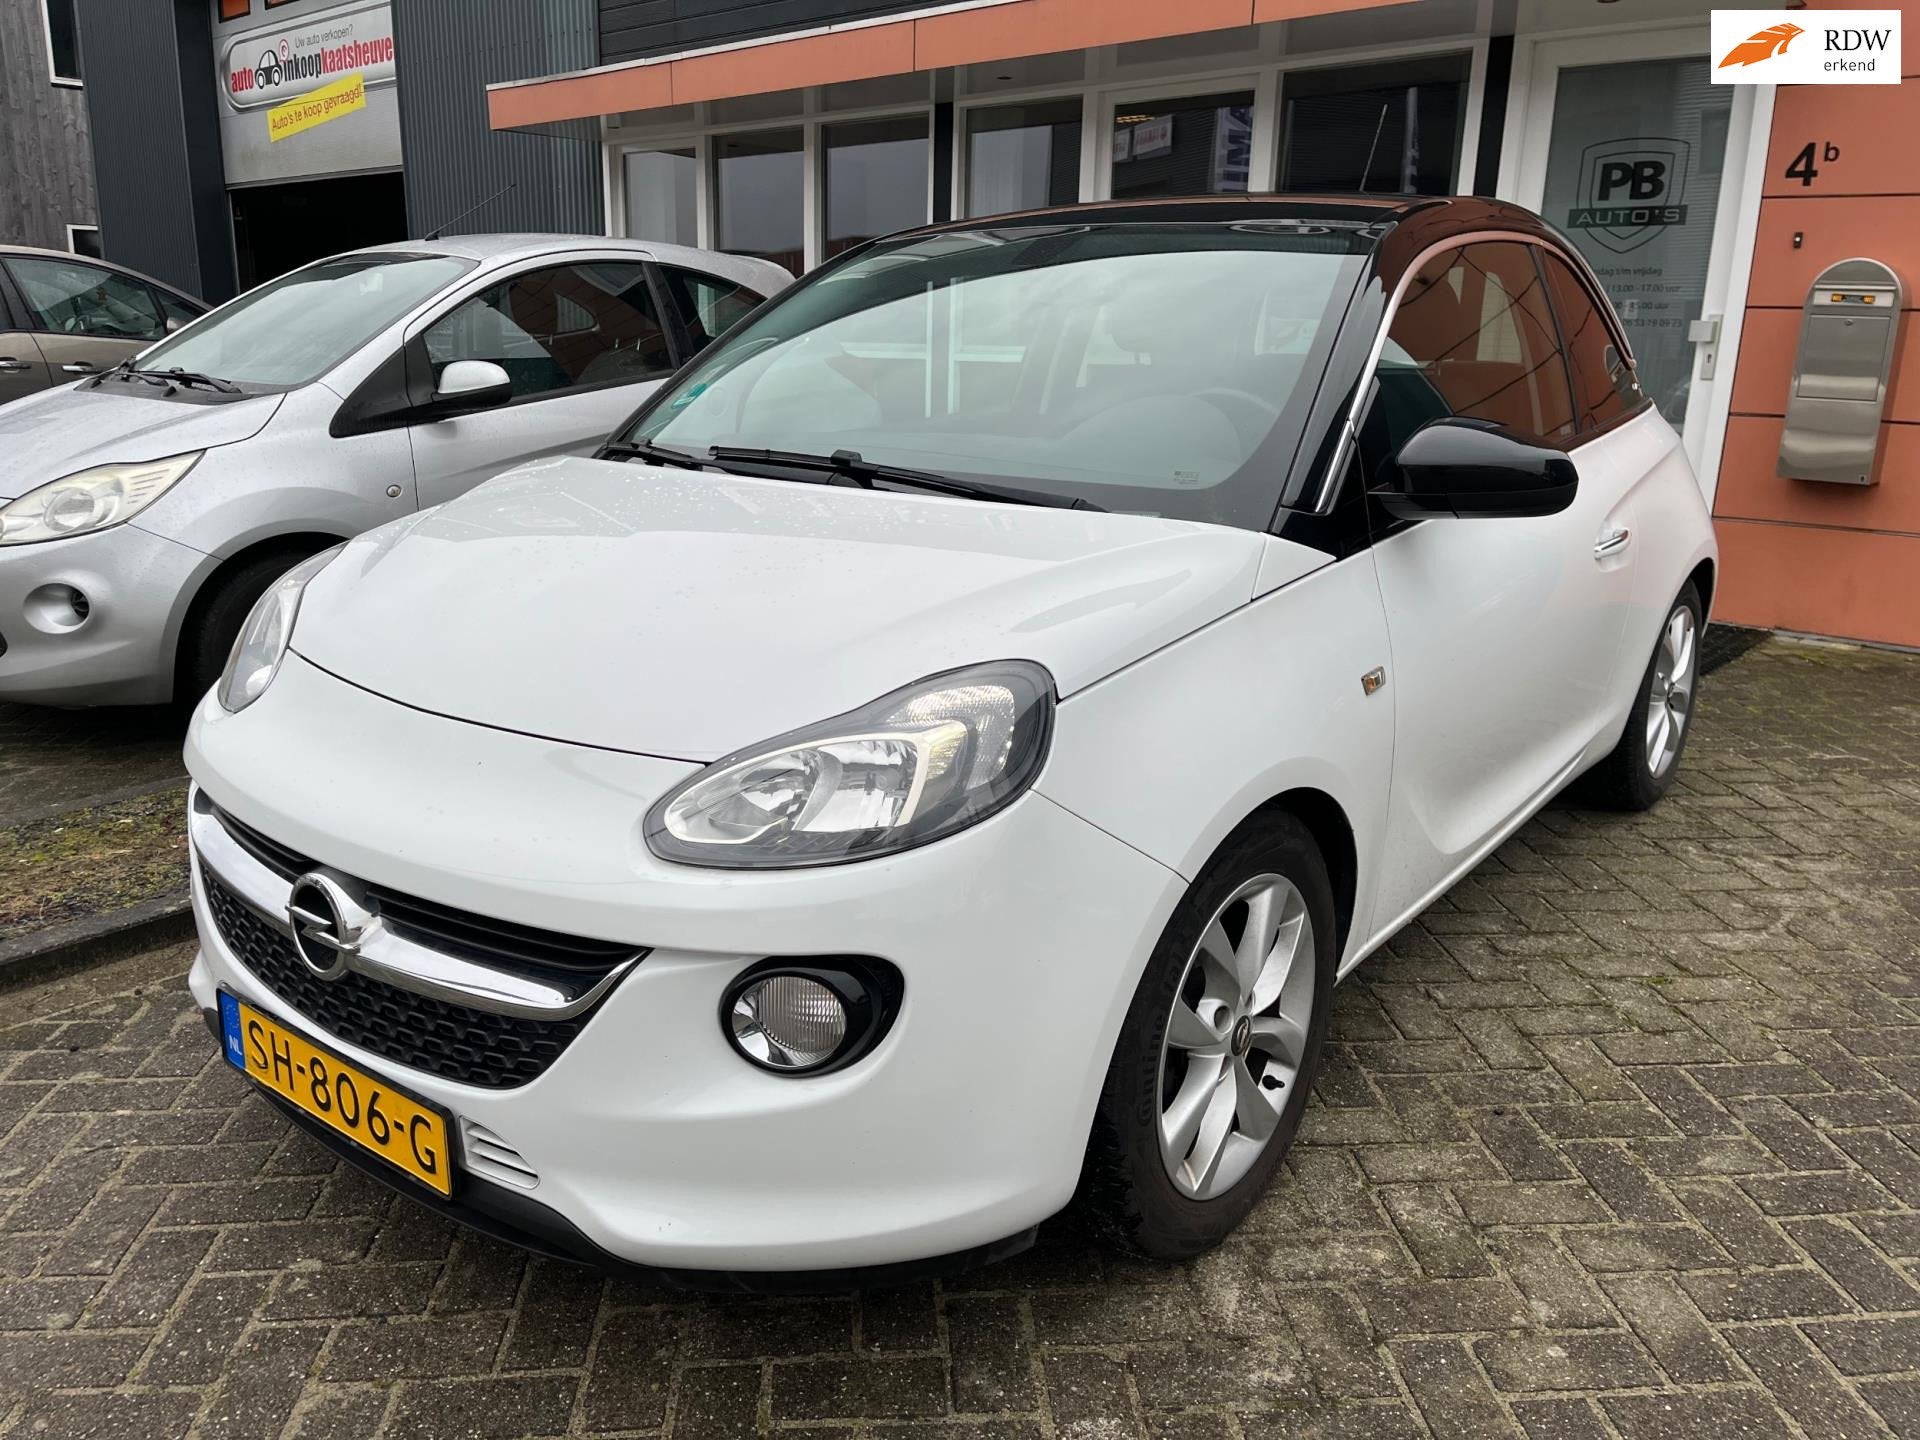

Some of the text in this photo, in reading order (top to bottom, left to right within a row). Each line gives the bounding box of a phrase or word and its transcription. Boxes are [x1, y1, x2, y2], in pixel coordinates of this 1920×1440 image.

[295, 24, 354, 48] Uw auto verkopen?
[231, 67, 254, 93] auto
[272, 83, 363, 132] Auto's te koop gevraagd!
[1598, 160, 1666, 201] PB
[1576, 208, 1680, 225] AUTO'S
[229, 1034, 243, 1056] NL
[248, 1020, 438, 1175] SH-806-G
